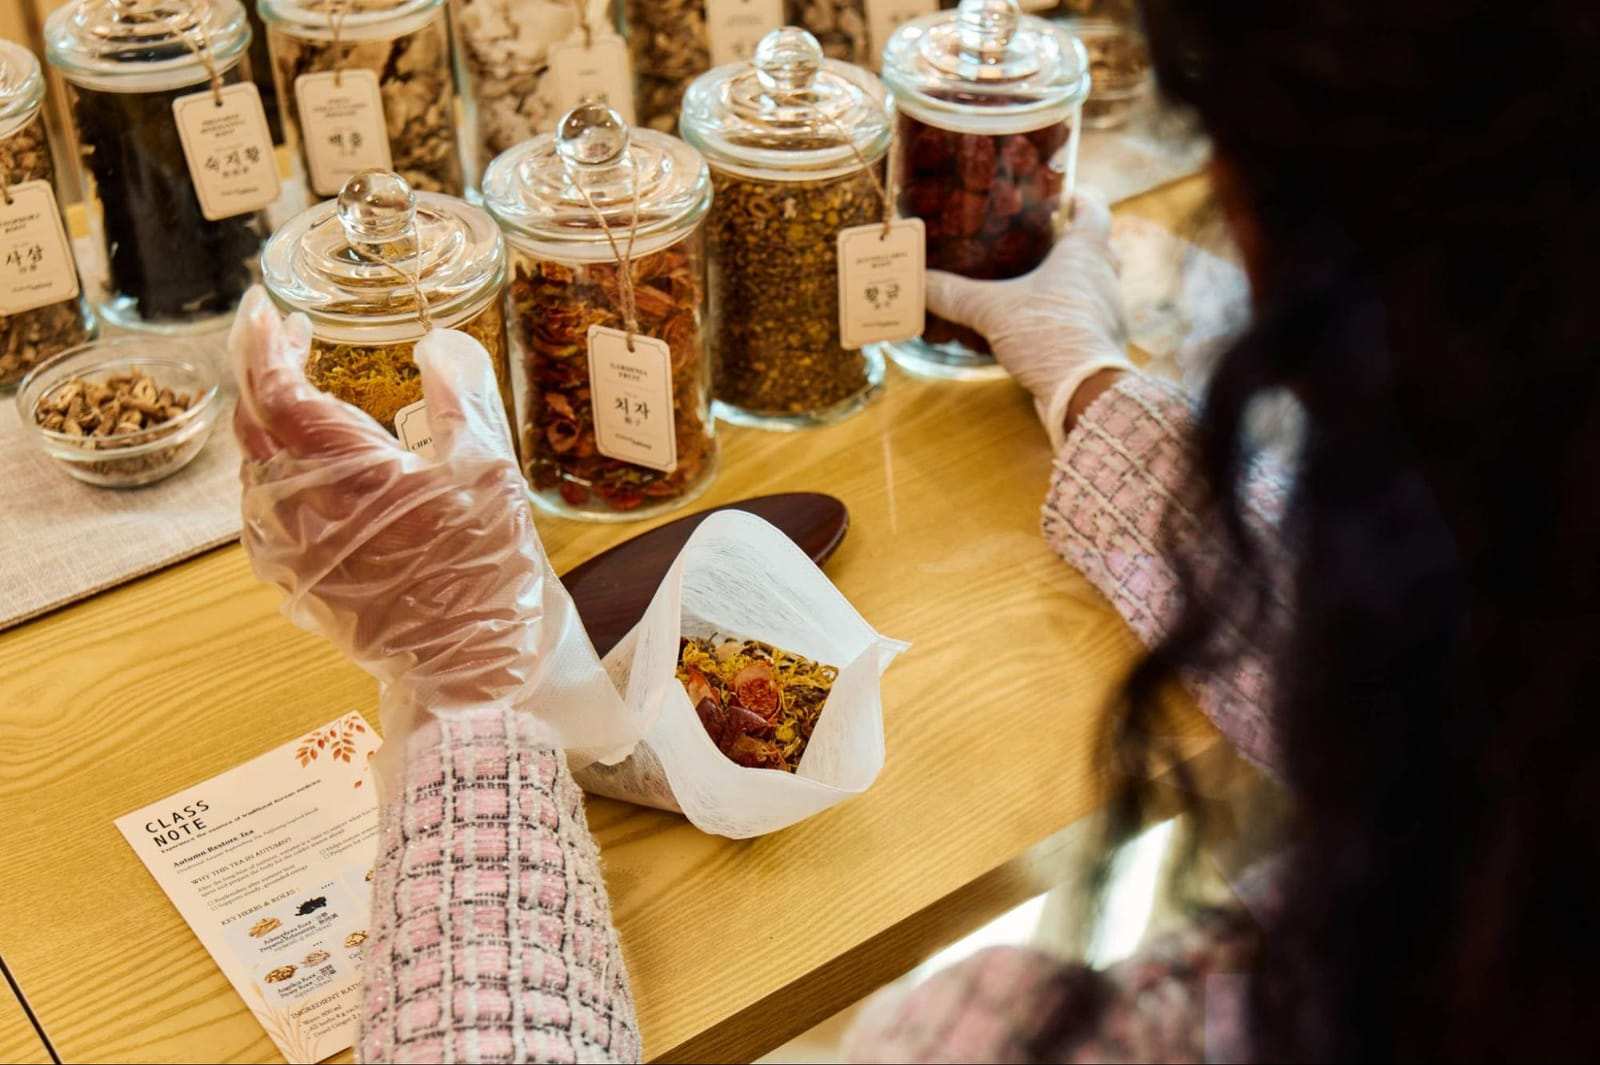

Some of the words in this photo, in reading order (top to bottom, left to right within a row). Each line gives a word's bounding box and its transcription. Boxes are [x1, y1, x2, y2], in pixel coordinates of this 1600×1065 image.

[614, 397, 650, 420] 치자
[145, 800, 209, 833] CLASS
[153, 818, 206, 847] NOTE
[174, 850, 207, 867] Autumn
[207, 837, 237, 852] Restore
[191, 875, 209, 884] WHY
[229, 859, 245, 868] TEA
